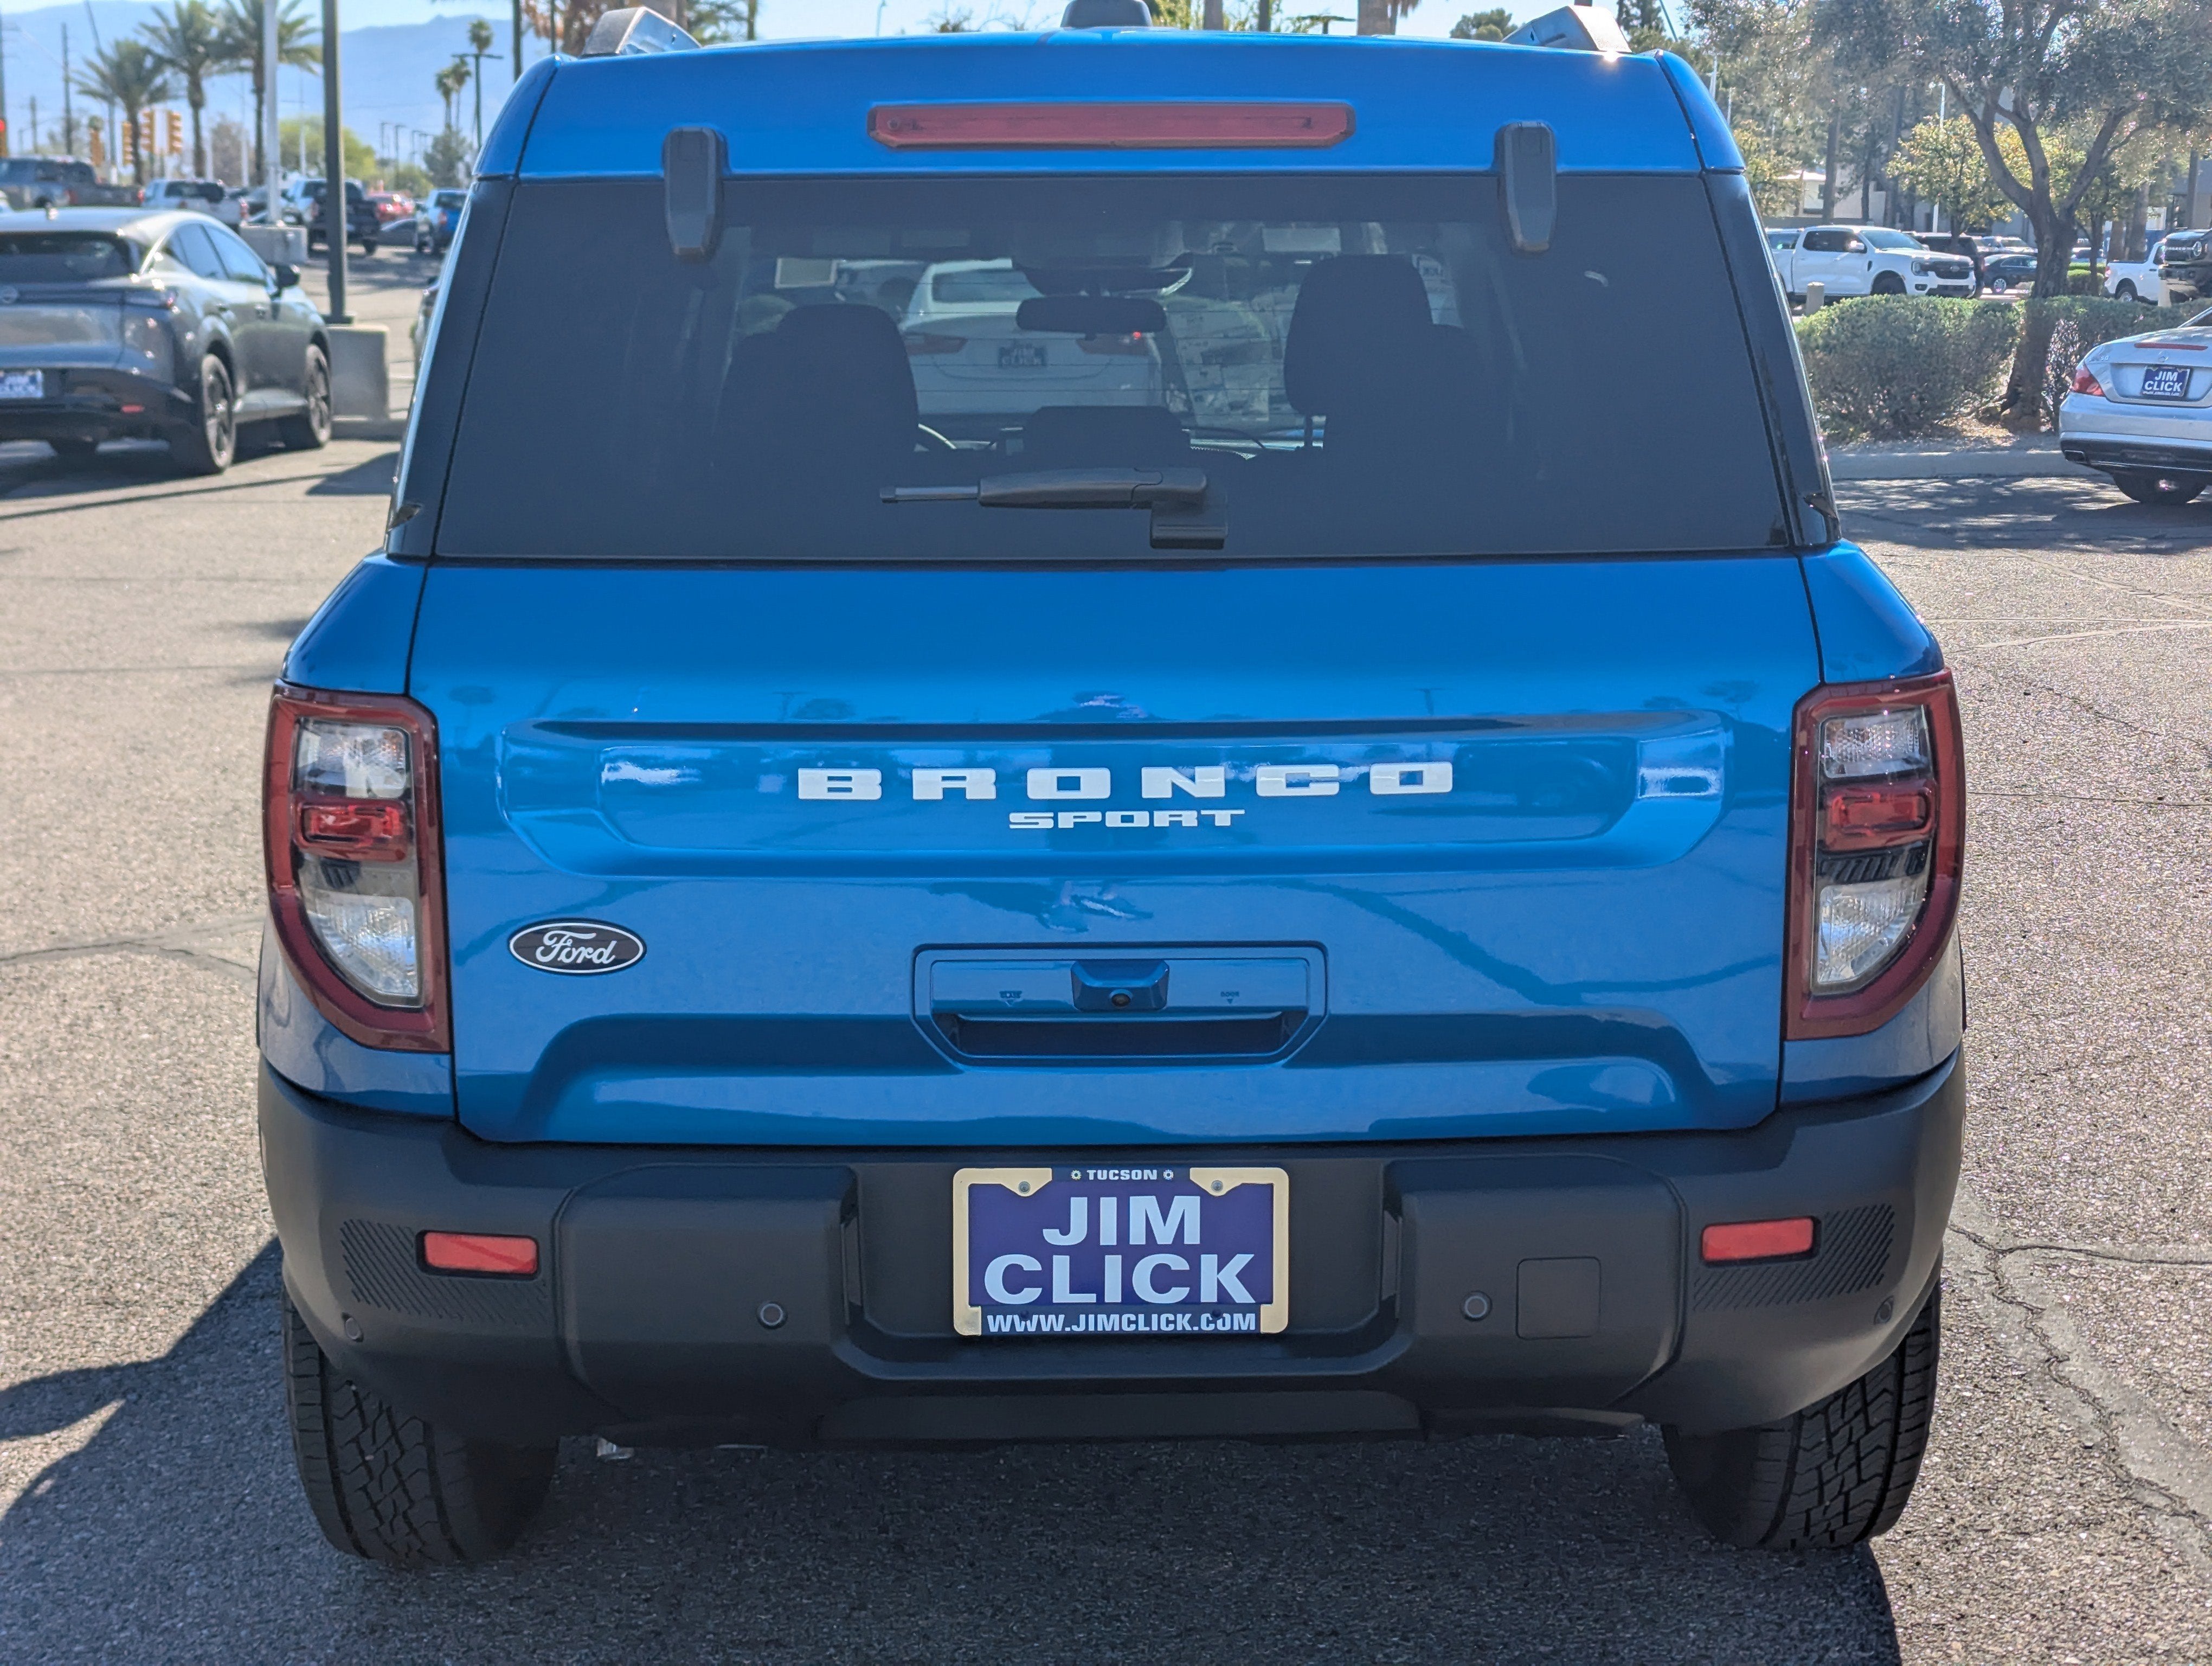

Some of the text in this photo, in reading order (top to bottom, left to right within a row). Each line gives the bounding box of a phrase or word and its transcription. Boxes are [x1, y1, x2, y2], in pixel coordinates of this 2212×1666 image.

[2155, 371, 2178, 381] JIM
[2144, 381, 2182, 392] CLICK
[798, 761, 1453, 800] BRONCO
[1009, 809, 1245, 829] SPORT
[536, 930, 617, 964] Ford
[1086, 1169, 1158, 1181] TUCSON
[1043, 1195, 1200, 1246] JIM
[984, 1253, 1256, 1304] CLICK
[987, 1313, 1256, 1332] WWW.JIMCLICK.COM
